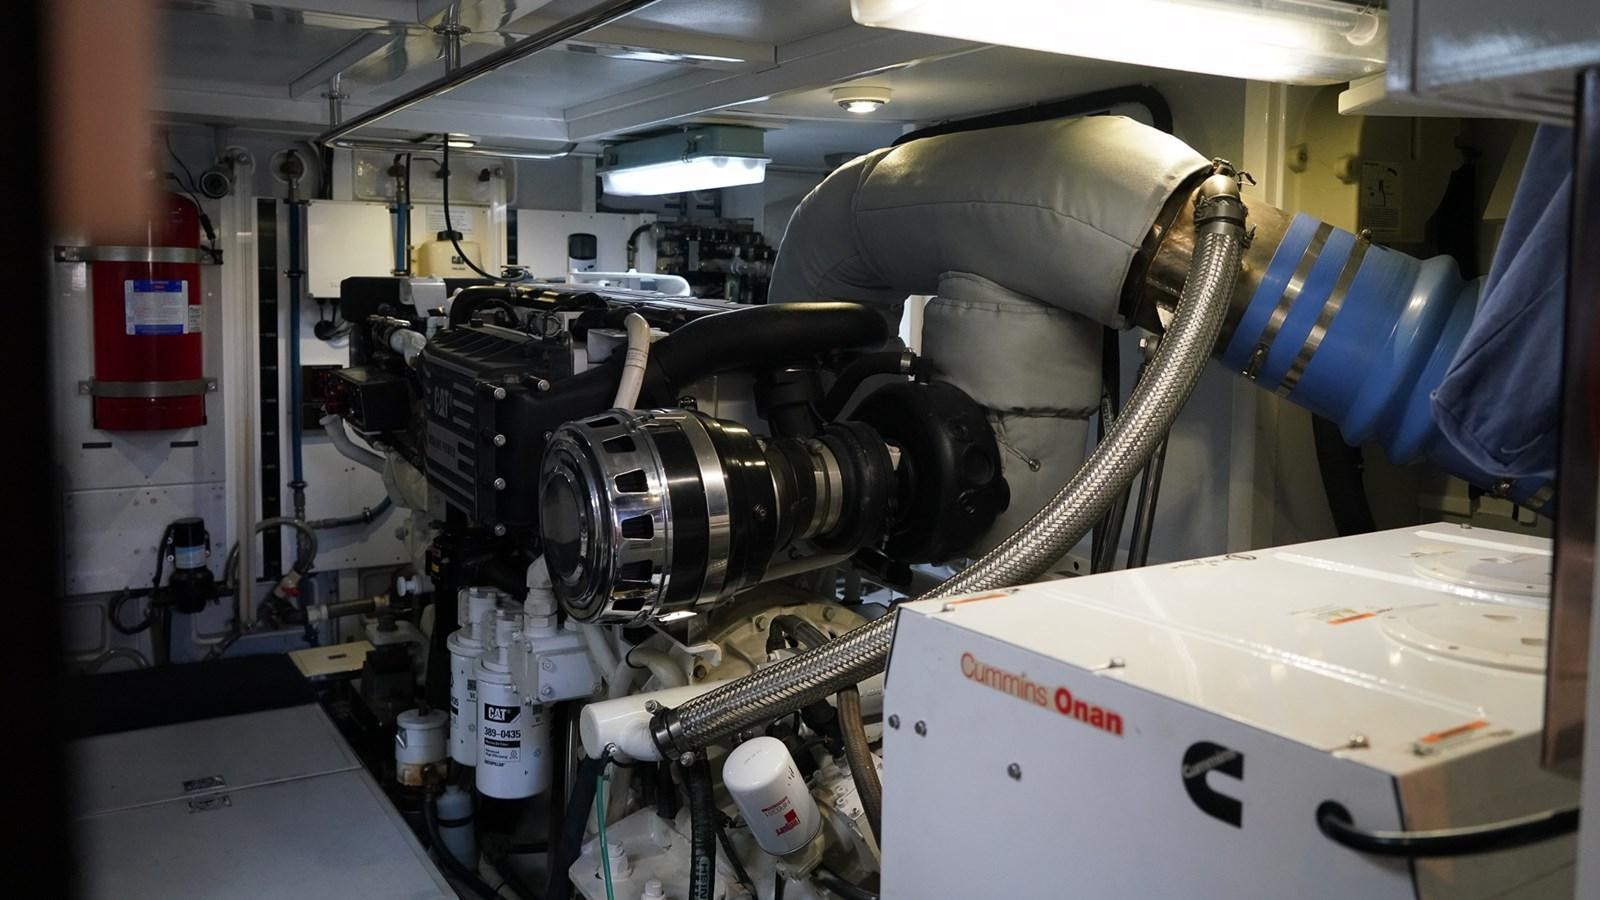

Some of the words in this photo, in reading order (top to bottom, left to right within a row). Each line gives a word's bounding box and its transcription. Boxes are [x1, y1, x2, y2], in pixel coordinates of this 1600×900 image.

[434, 386, 448, 418] CAT
[960, 652, 1048, 707] Cummins
[1054, 687, 1124, 736] Onan
[488, 706, 507, 720] CAT
[484, 726, 521, 739] 389-0435
